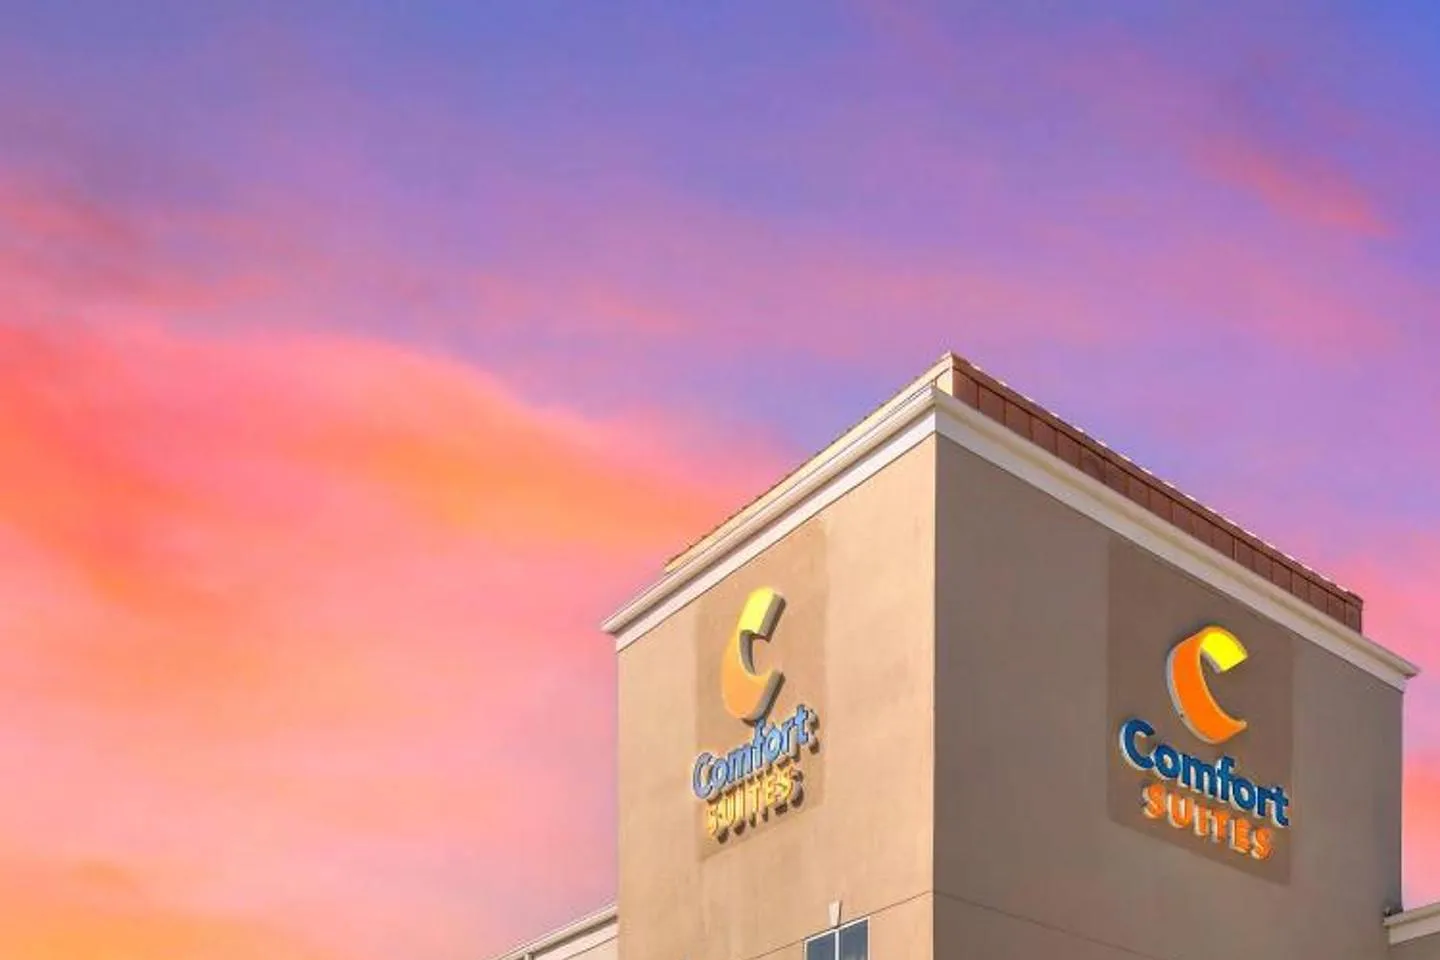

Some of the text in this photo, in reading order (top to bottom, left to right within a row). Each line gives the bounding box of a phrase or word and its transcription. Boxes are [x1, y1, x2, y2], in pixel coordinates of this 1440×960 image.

[692, 704, 809, 800] Comfort
[1119, 718, 1289, 828] Comfort
[706, 763, 797, 839] SUITES
[1142, 783, 1274, 861] SUITES
